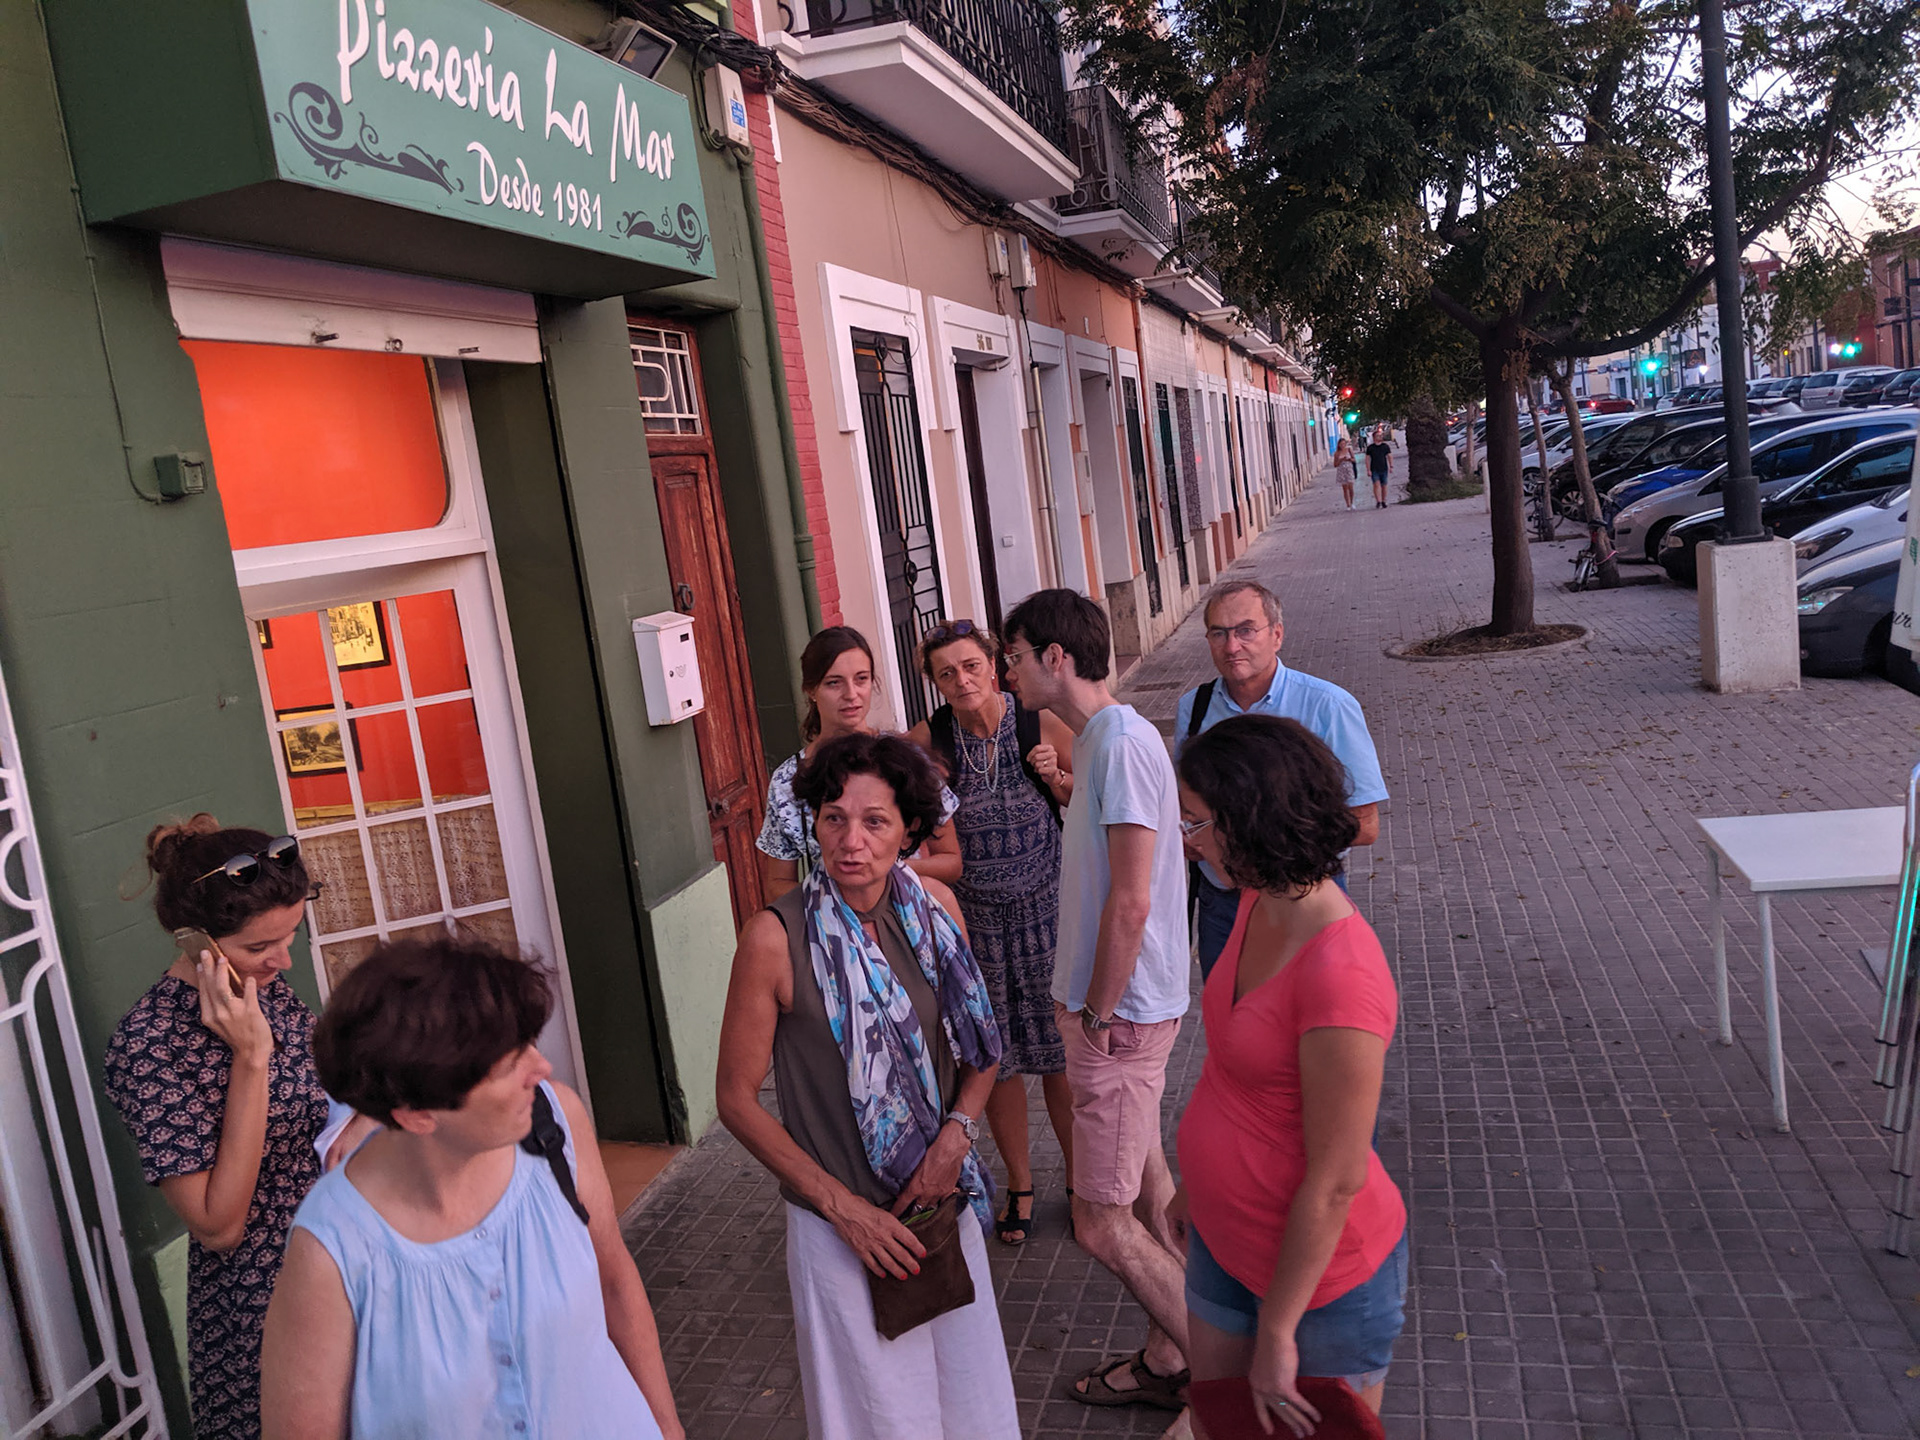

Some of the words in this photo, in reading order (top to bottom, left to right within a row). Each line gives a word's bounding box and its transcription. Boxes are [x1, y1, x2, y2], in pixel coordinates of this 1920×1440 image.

[546, 48, 593, 155] La
[610, 83, 675, 182] Mar
[467, 142, 544, 217] Desde
[553, 182, 602, 231] 1981
